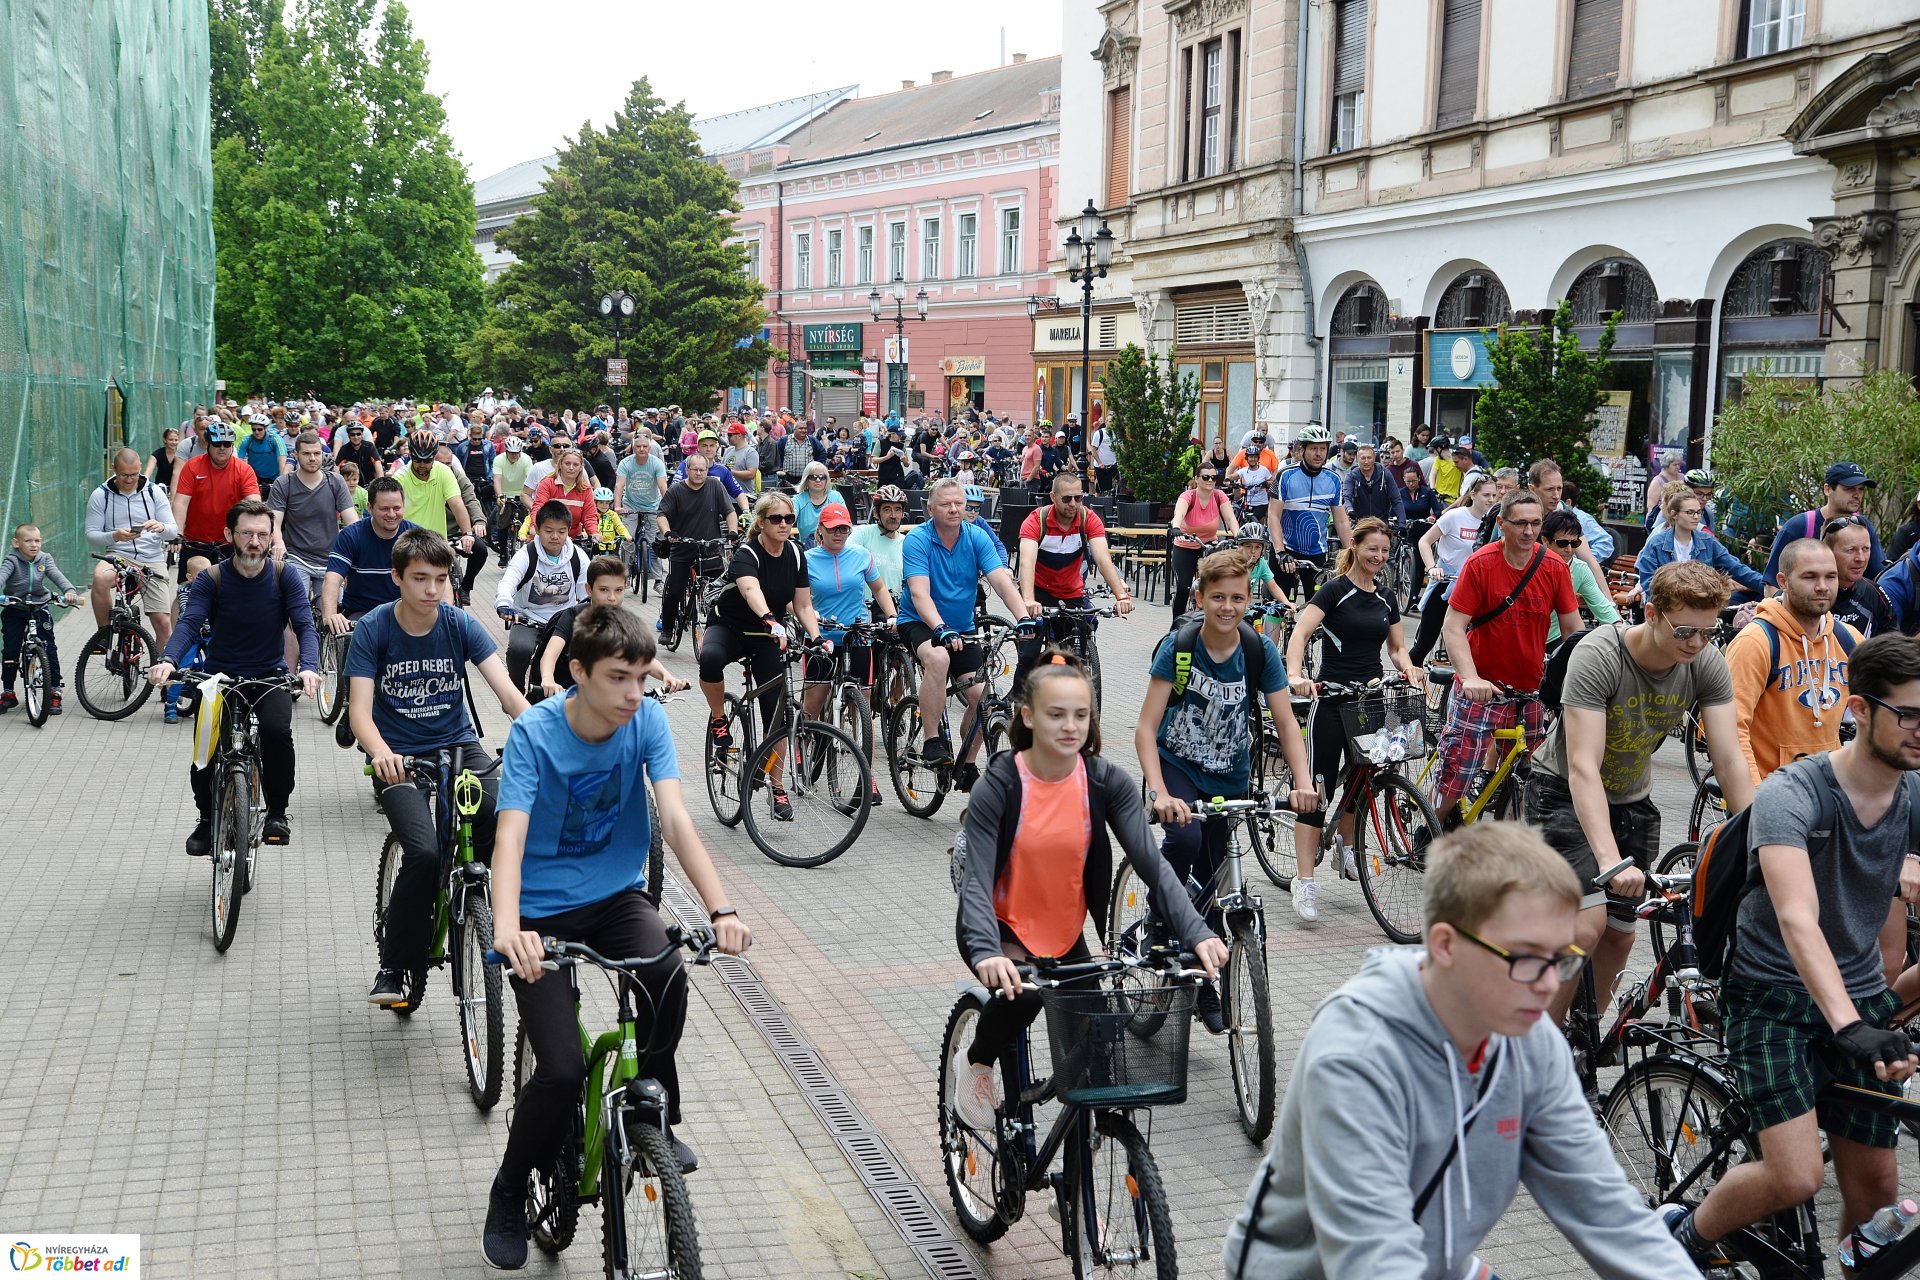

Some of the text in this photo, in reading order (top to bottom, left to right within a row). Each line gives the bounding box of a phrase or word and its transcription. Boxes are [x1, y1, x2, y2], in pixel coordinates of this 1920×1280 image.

[809, 326, 854, 343] NYÍRSÉG
[1049, 327, 1081, 341] MARELLA
[386, 658, 456, 679] SPEED REBEL
[381, 673, 460, 706] Racing Club
[410, 678, 424, 687] 1973
